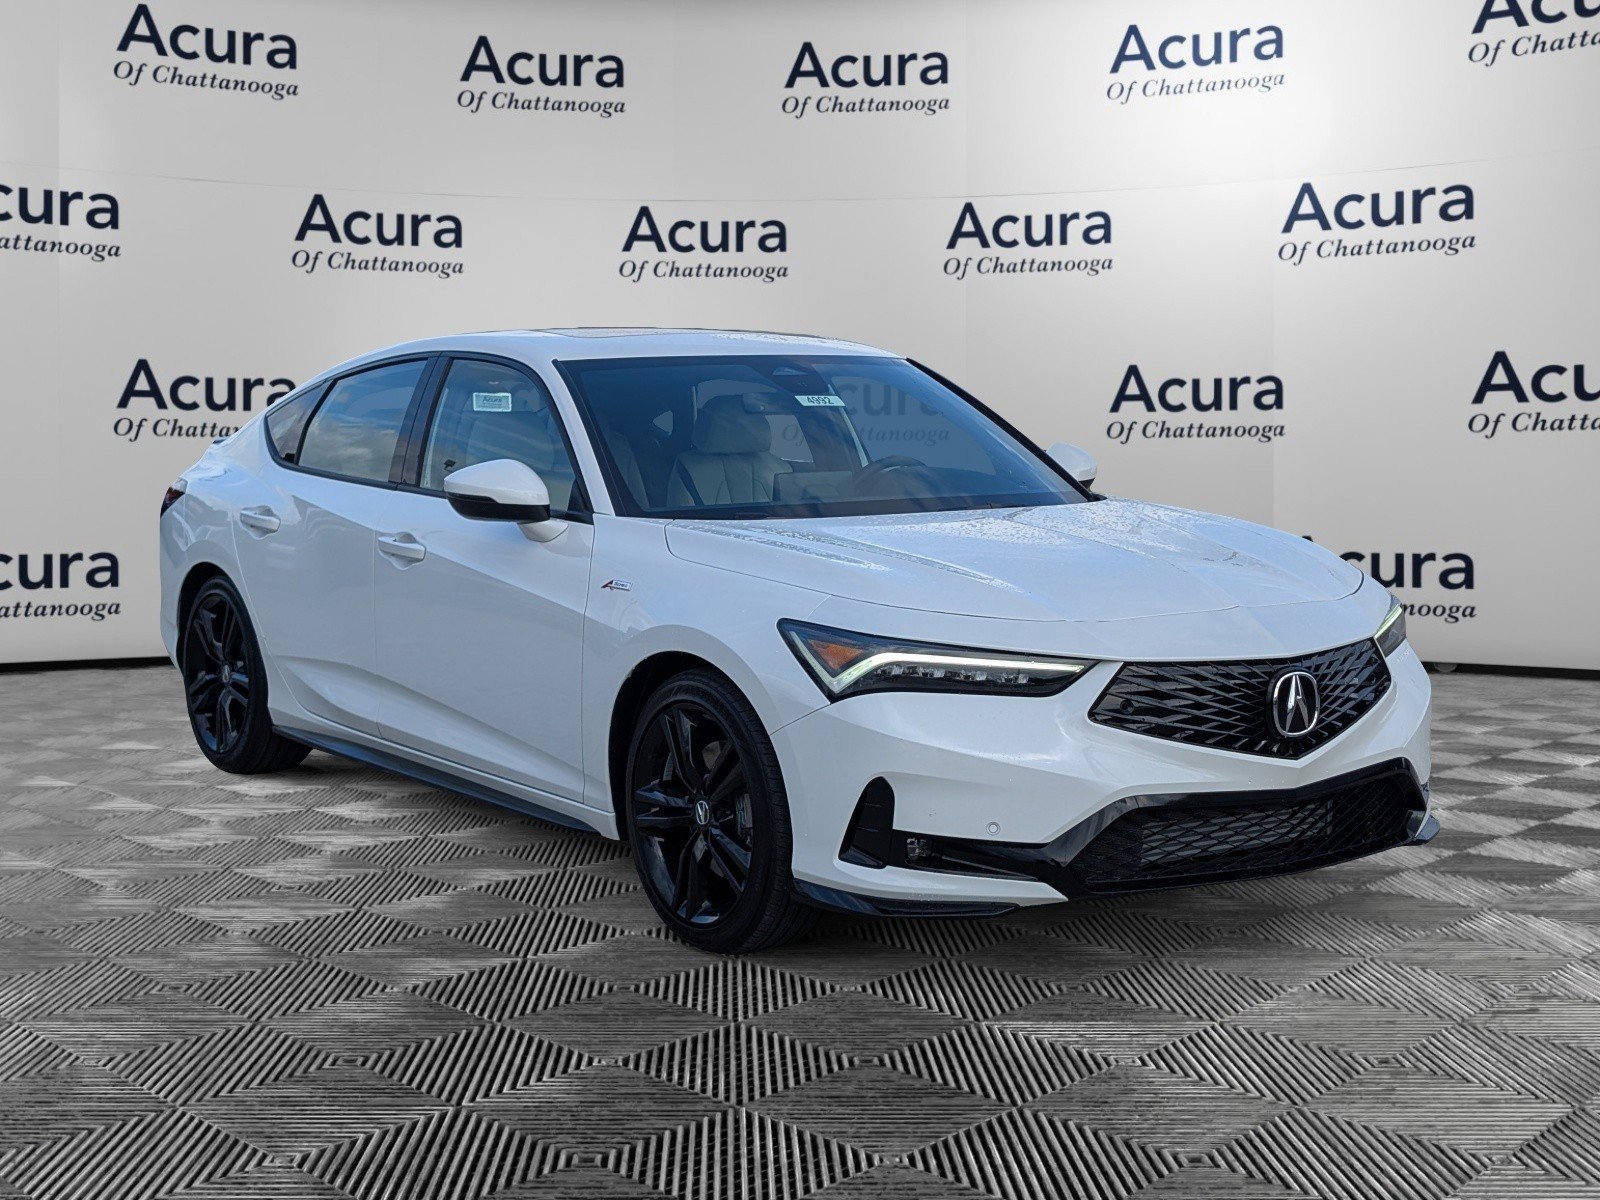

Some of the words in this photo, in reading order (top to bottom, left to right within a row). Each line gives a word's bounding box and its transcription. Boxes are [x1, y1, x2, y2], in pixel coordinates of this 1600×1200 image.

[116, 3, 297, 70] Acura
[1109, 24, 1284, 75] Acura
[460, 35, 624, 88] Acura
[784, 40, 948, 88] Acura
[1468, 38, 1506, 67] Of
[113, 61, 149, 87] Of
[151, 65, 298, 101] Chattanooga
[1107, 81, 1138, 105] Of
[1141, 75, 1285, 98] Chattanooga
[457, 90, 488, 114] Of
[490, 91, 625, 118] Chattanooga
[781, 95, 813, 119] Of
[815, 95, 949, 115] Chattanooga
[294, 194, 462, 248] Acura
[1280, 182, 1475, 235] Acura
[621, 206, 787, 253] Acura
[945, 202, 1112, 250] Acura
[292, 250, 323, 275] Of
[326, 251, 464, 279] Chattanooga
[1278, 240, 1312, 267] Of
[1316, 236, 1476, 259] Chattanooga
[619, 260, 650, 284] Of
[652, 260, 788, 283] Chattanooga
[943, 257, 973, 281] Of
[976, 257, 1113, 276] Chattanooga
[806, 396, 835, 405] 4992
[1109, 364, 1283, 413] Acura
[114, 418, 148, 442] Of
[1107, 420, 1138, 445] Of
[1141, 420, 1286, 443] Chattanooga
[1468, 413, 1506, 439] Of
[1301, 535, 1474, 590] ura
